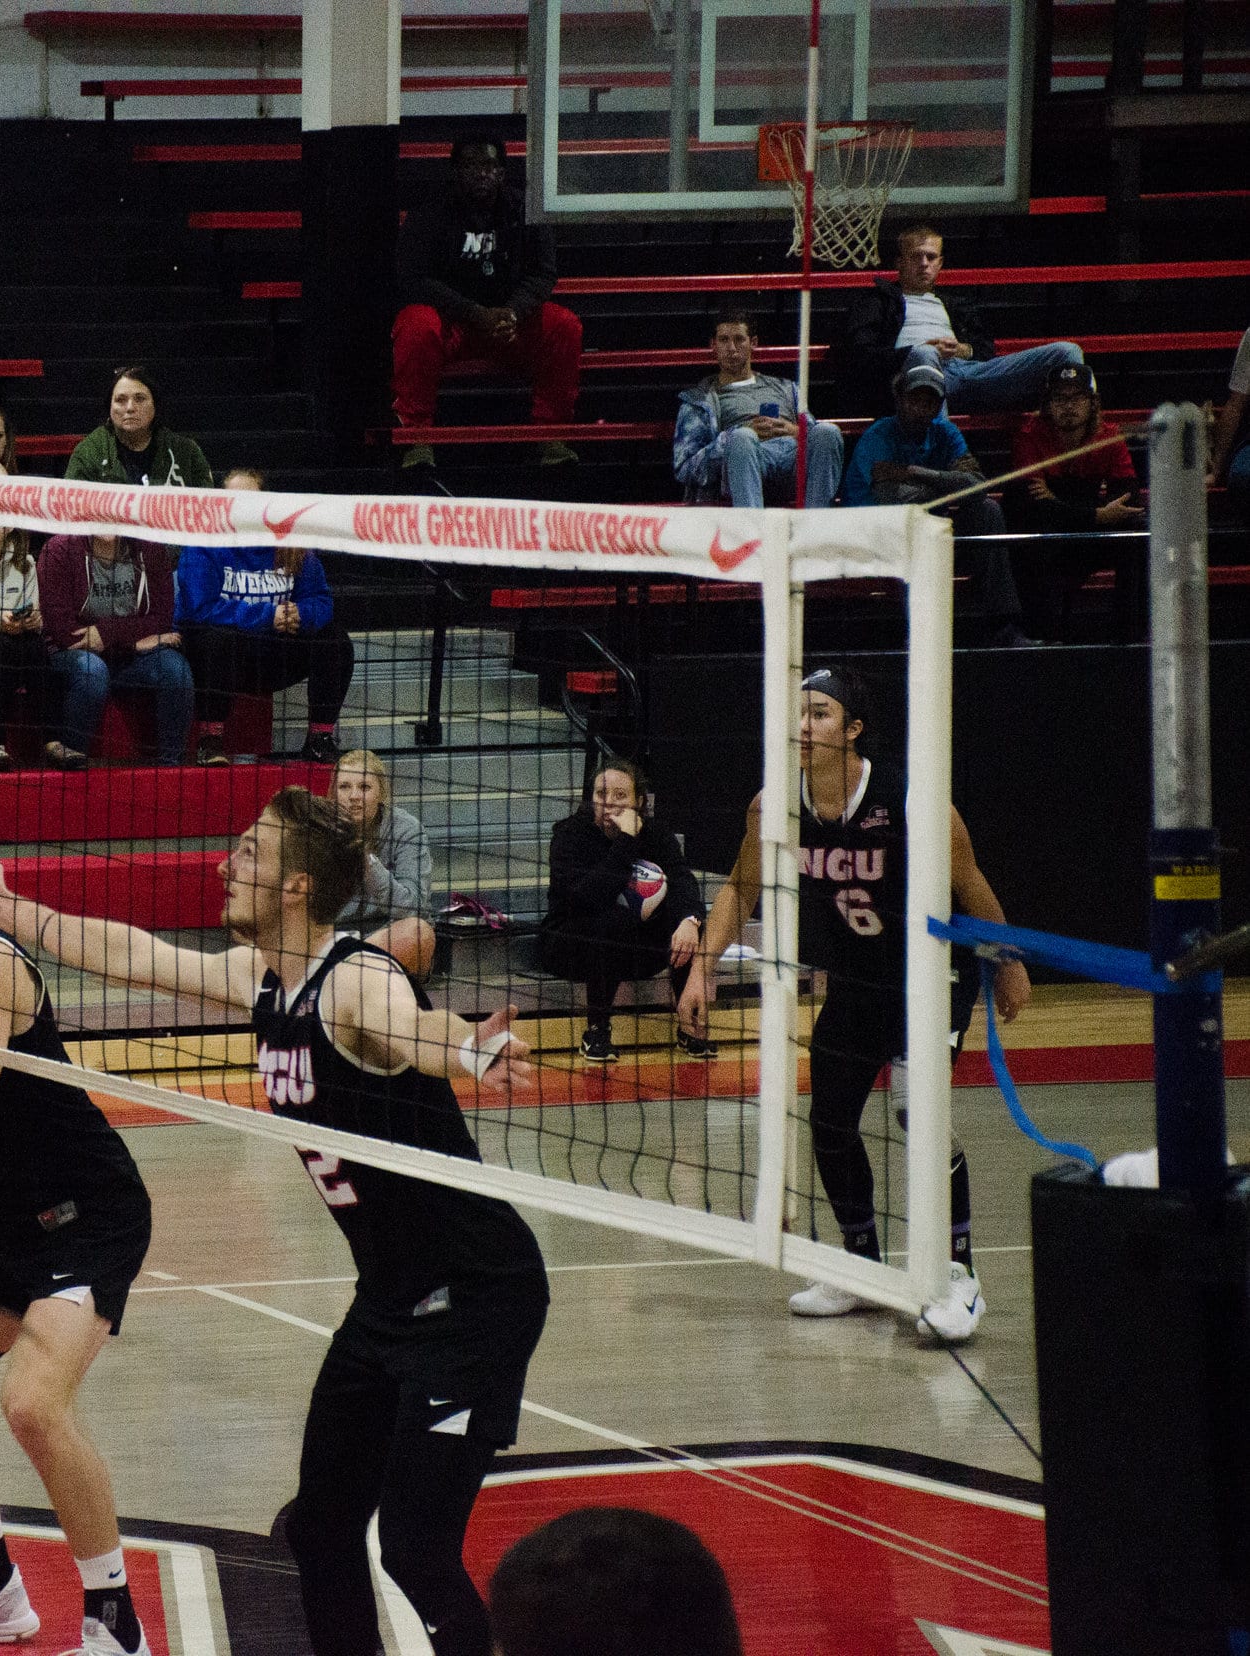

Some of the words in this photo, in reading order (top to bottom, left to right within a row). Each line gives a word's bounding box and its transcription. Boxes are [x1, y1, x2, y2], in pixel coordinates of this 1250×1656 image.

[46, 486, 142, 527] GREENVILLE
[138, 493, 237, 534] UNIVERSITY
[353, 502, 422, 545] NORTH
[426, 504, 542, 551] GREENVILLE
[544, 508, 670, 558] UNIVERSITY
[834, 887, 885, 936] 6
